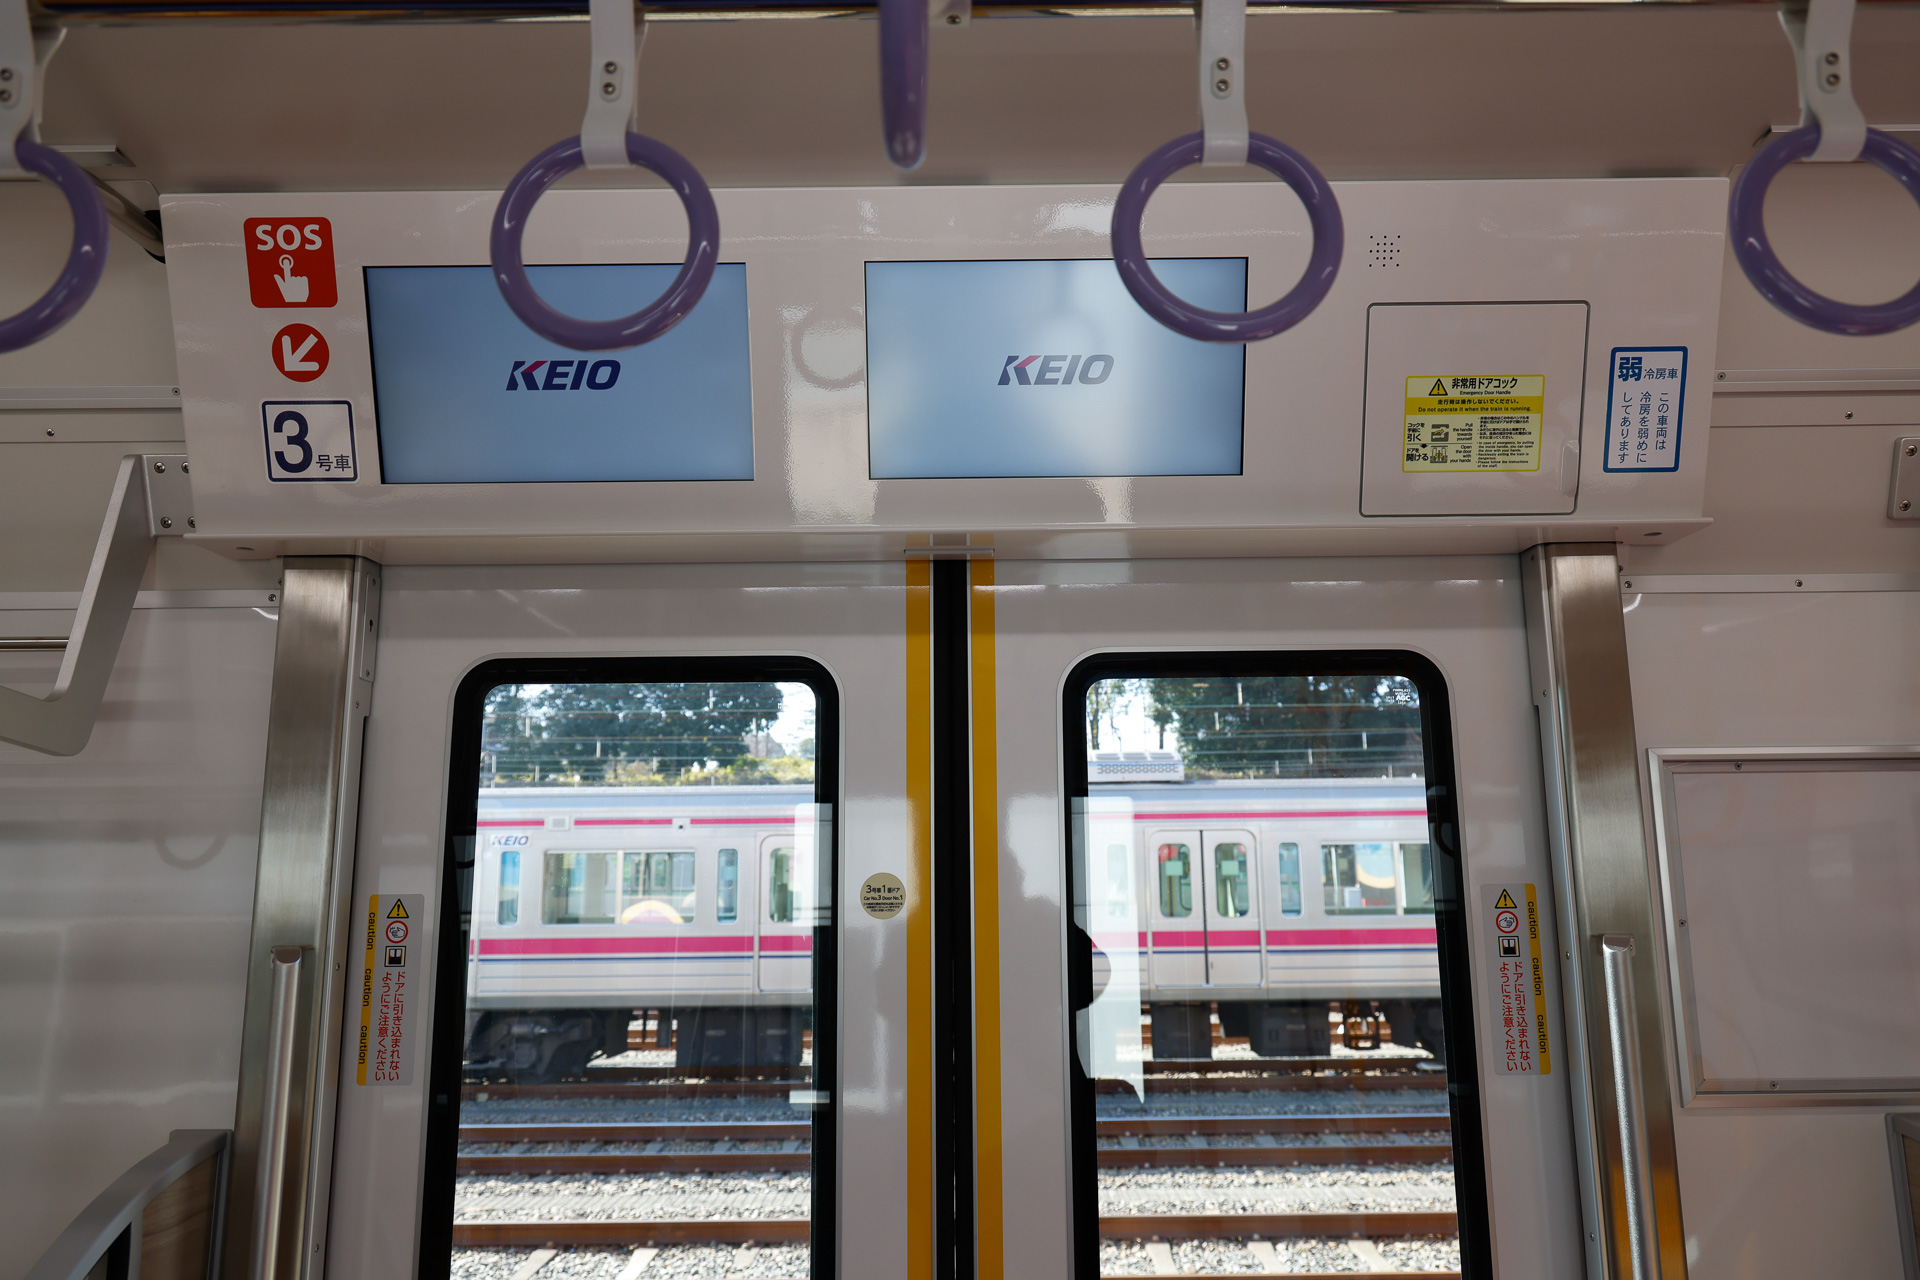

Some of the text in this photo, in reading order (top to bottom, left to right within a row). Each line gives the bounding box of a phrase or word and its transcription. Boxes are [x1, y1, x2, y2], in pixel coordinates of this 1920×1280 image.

[255, 224, 322, 251] SOS
[505, 359, 621, 391] KEIO
[997, 354, 1115, 386] KEIO
[1451, 377, 1518, 390] 非常用ドアコック
[1618, 356, 1679, 382] 弱冷房車
[1407, 434, 1422, 442] 引く
[1618, 392, 1633, 464] してあります
[1636, 391, 1652, 463] 冷房を弱めに
[1655, 392, 1669, 451] この車両は
[273, 410, 352, 473] 3号車
[1406, 453, 1428, 462] 開ける
[492, 836, 529, 846] KEIO
[367, 912, 376, 950] caution
[1528, 901, 1537, 939] caution
[362, 968, 372, 1007] caution
[1532, 957, 1541, 996] caution
[375, 971, 392, 1081] ようにご注意ください
[388, 971, 406, 1081] ドアに引き込まれない
[1500, 962, 1518, 1071] ようにご注意ください
[1513, 961, 1532, 1071] ドアに引き込まれない
[1537, 1014, 1546, 1054] caution
[358, 1025, 367, 1065] caution
